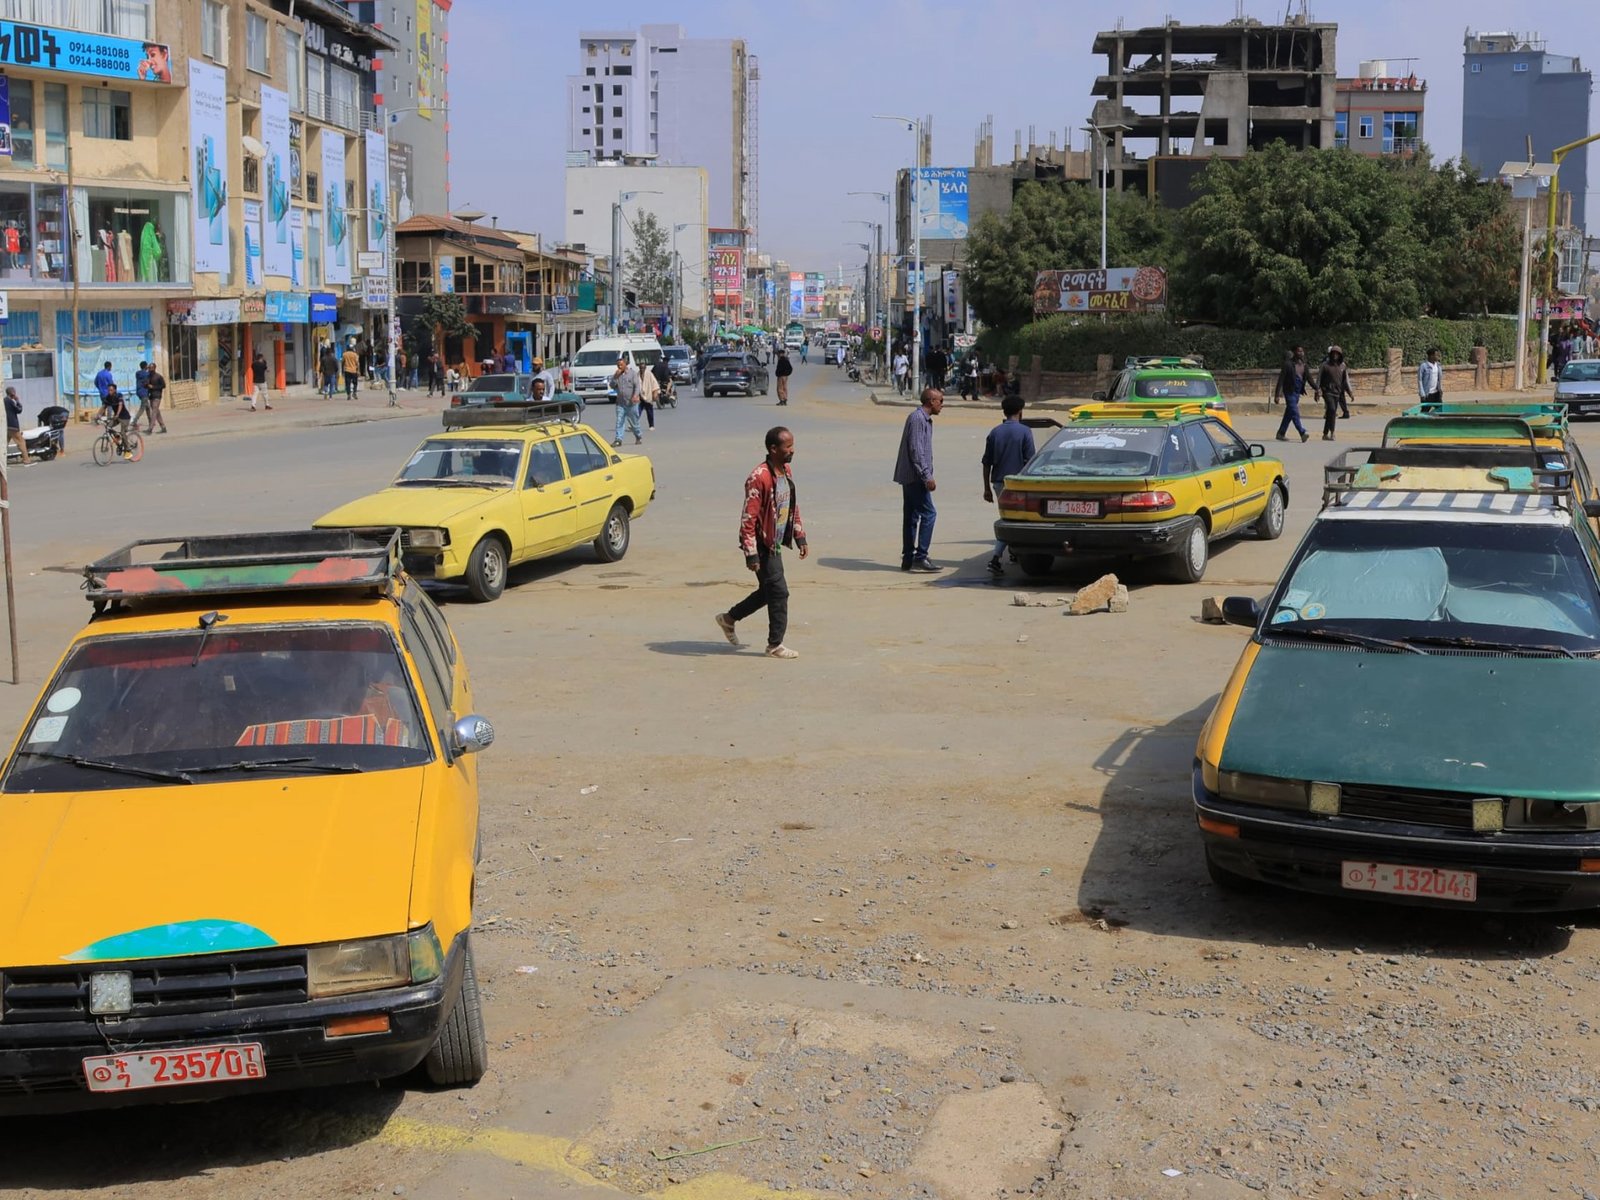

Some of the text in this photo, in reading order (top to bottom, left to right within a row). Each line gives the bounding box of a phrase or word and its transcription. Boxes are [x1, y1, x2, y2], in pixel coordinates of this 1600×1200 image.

[69, 42, 130, 59] 0914-881088
[69, 55, 131, 72] 0914-888008
[1061, 270, 1106, 290] ሮማናት
[1393, 868, 1460, 896] 13204
[150, 1050, 243, 1082] 23570
